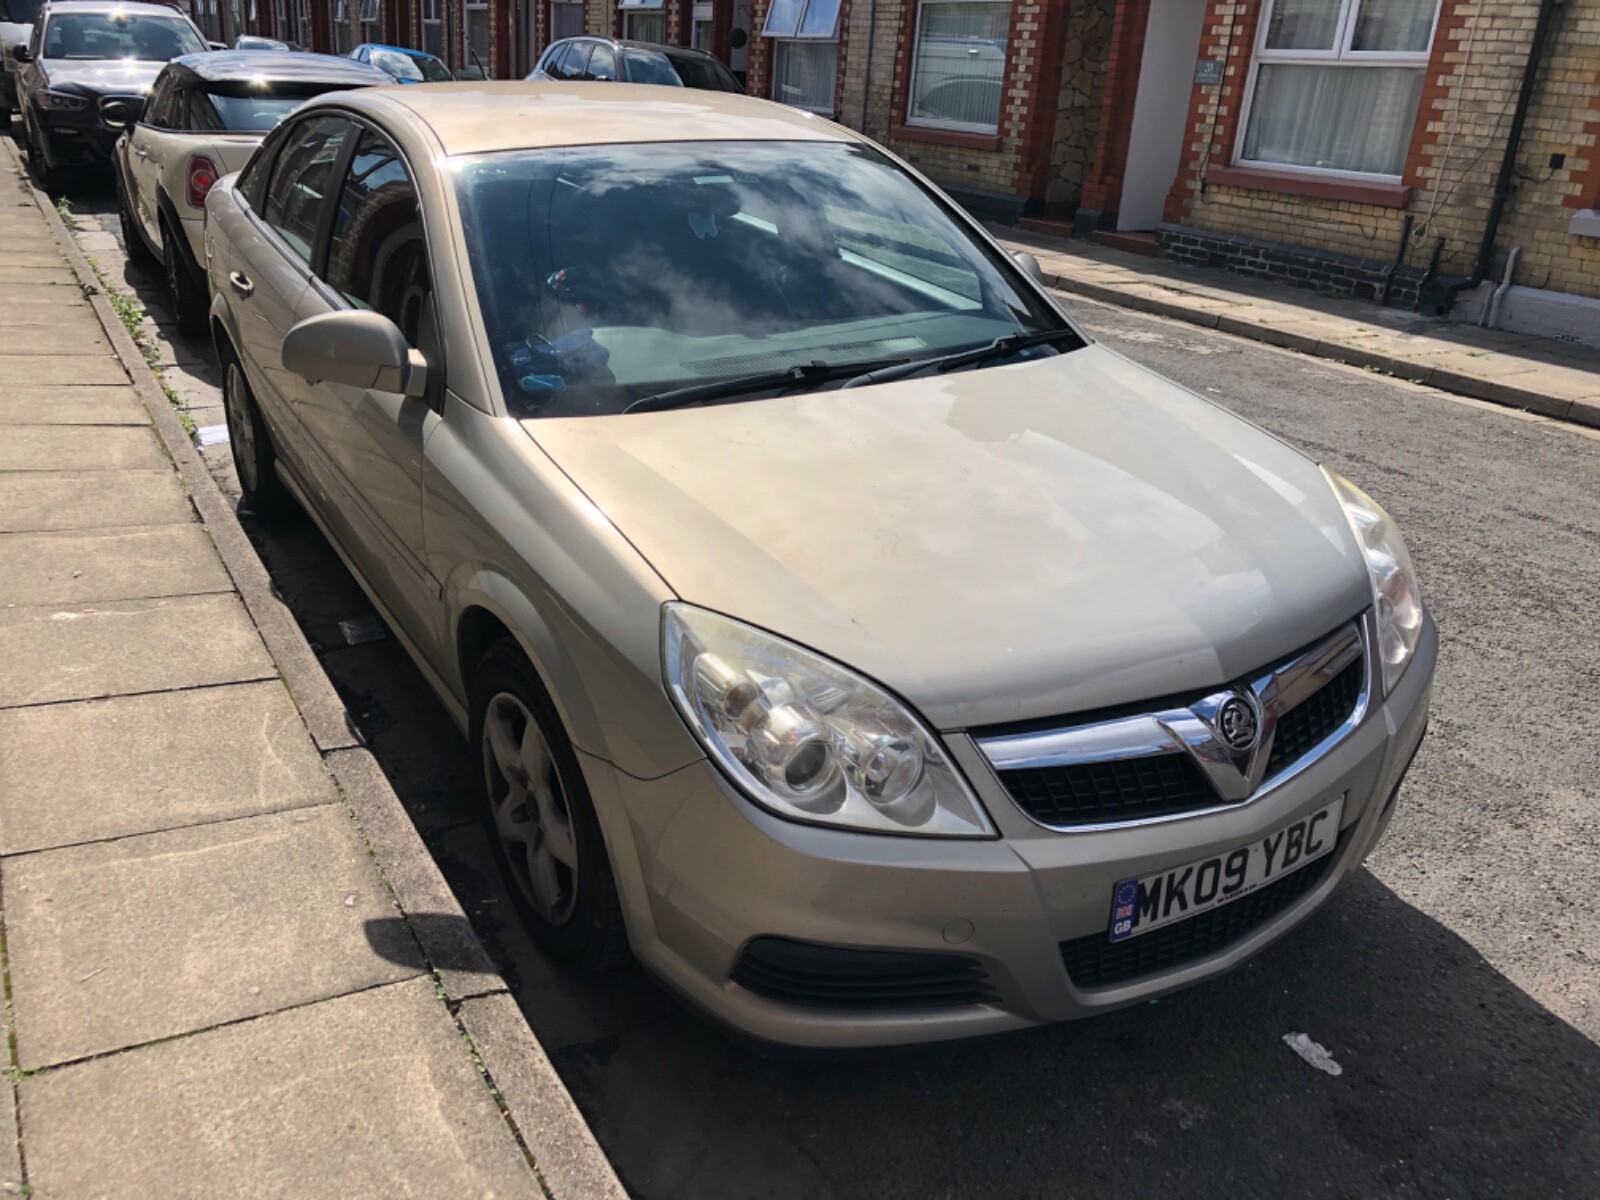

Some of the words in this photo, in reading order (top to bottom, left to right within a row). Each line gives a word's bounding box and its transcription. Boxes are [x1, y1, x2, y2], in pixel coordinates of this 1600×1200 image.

[1204, 62, 1214, 73] 31
[1132, 848, 1249, 928] MK09
[1263, 810, 1328, 877] YBC
[1114, 920, 1131, 934] GB
